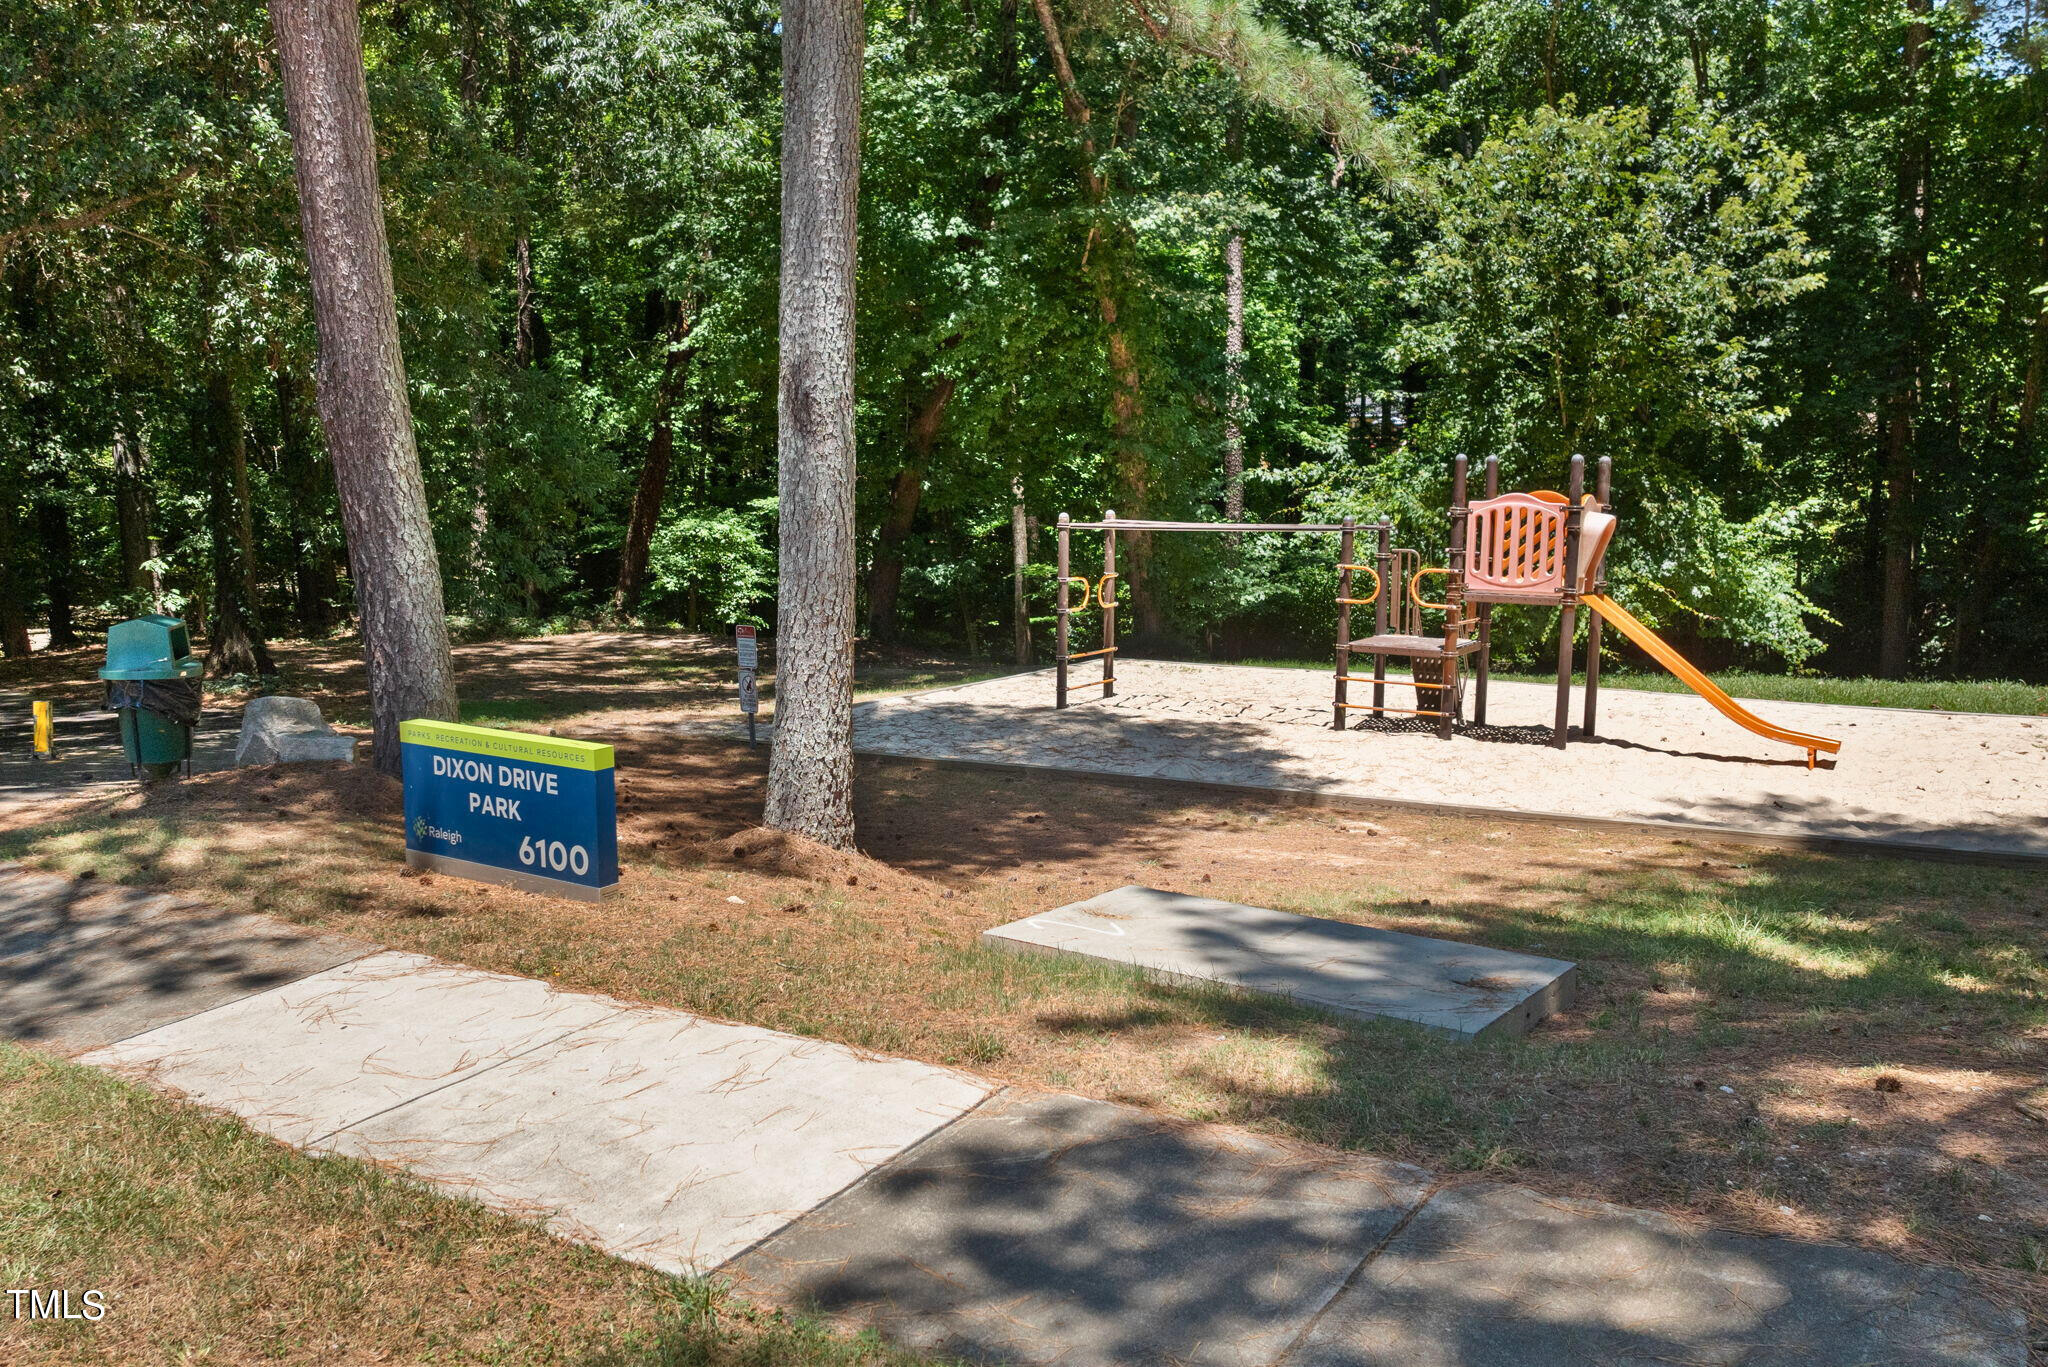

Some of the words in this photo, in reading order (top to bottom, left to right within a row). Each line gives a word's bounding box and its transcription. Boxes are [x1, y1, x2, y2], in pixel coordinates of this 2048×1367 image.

[436, 734, 483, 748] RECREATION
[493, 742, 533, 755] CULTURAL
[536, 748, 585, 763] RESOURCES
[433, 755, 493, 784] DIXON
[498, 765, 558, 795] DRIVE
[469, 792, 522, 822] PARK
[428, 825, 462, 845] Raleigh
[519, 836, 589, 876] 6100
